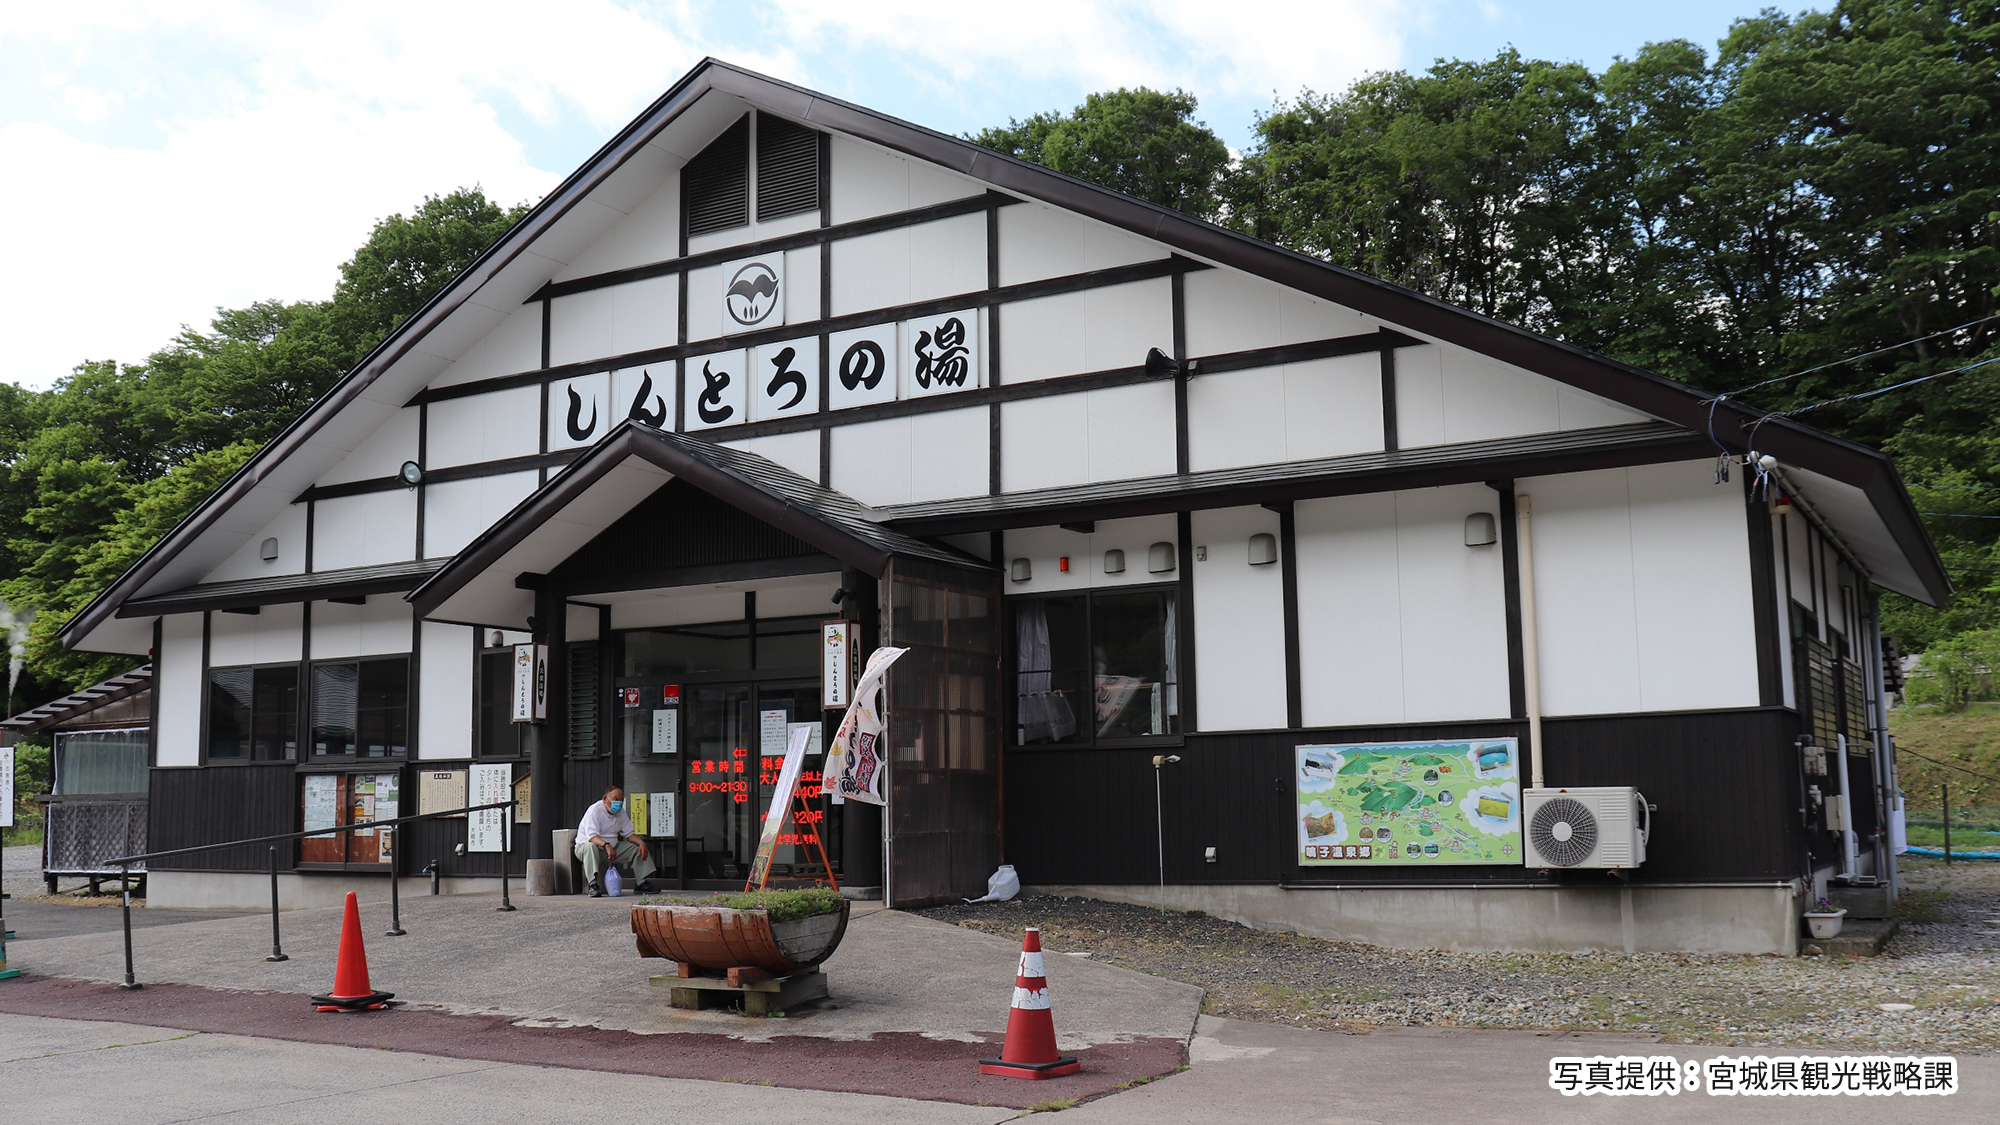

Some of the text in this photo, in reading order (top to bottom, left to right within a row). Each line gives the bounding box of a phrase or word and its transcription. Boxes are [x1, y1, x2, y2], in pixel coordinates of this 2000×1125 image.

[566, 317, 970, 441] しんとろの湯
[691, 760, 745, 774] 営業時間
[761, 757, 785, 770] 料金
[1305, 846, 1372, 858] 鳴子温泉郷
